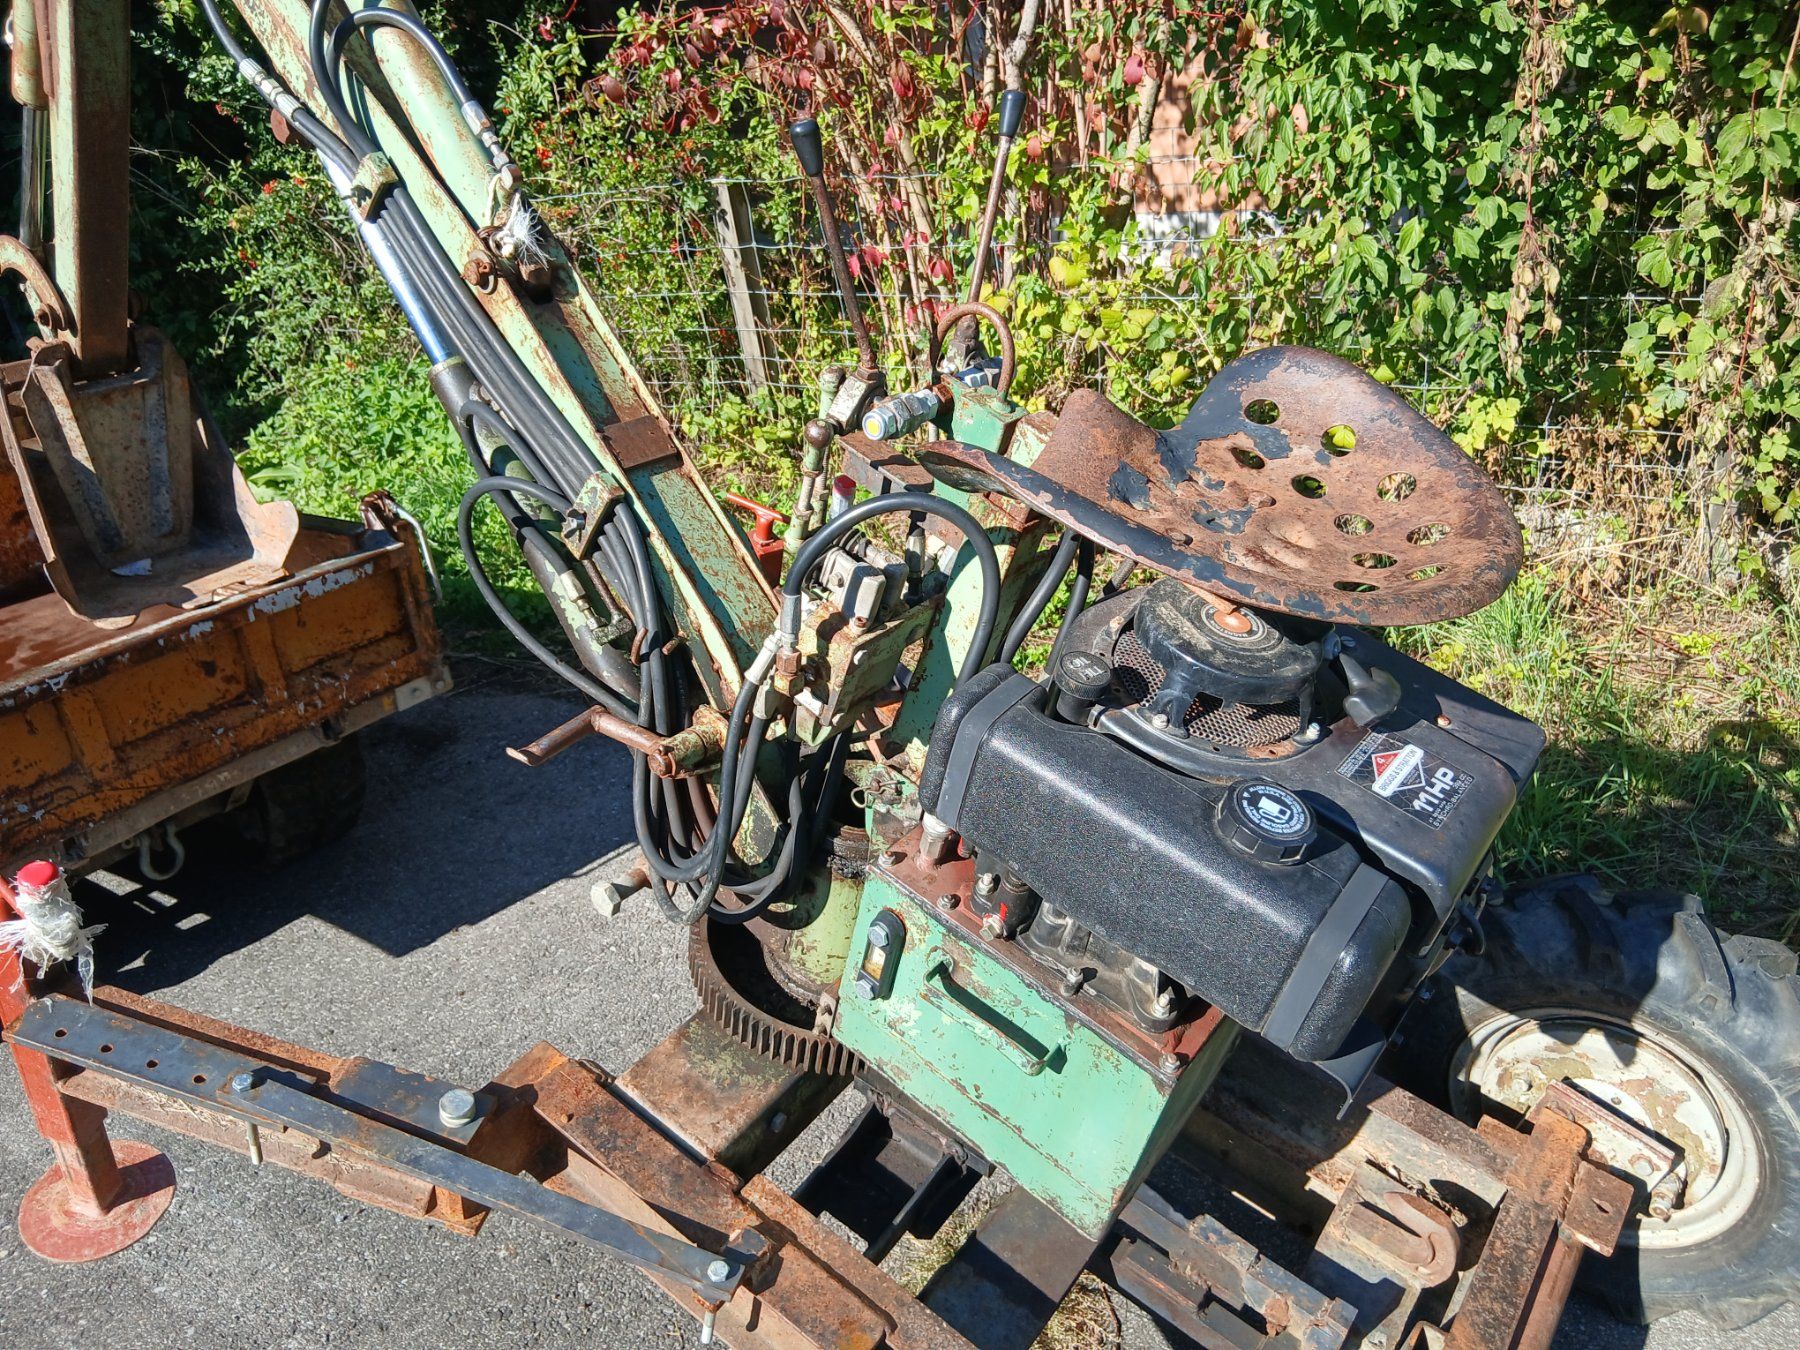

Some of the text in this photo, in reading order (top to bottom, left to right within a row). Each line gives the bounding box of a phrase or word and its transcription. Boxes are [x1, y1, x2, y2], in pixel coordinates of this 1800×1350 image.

[1068, 657, 1091, 669] OIL
[1079, 666, 1105, 681] FILL
[1379, 772, 1396, 792] BRIGGS
[1396, 748, 1417, 771] STRATTON
